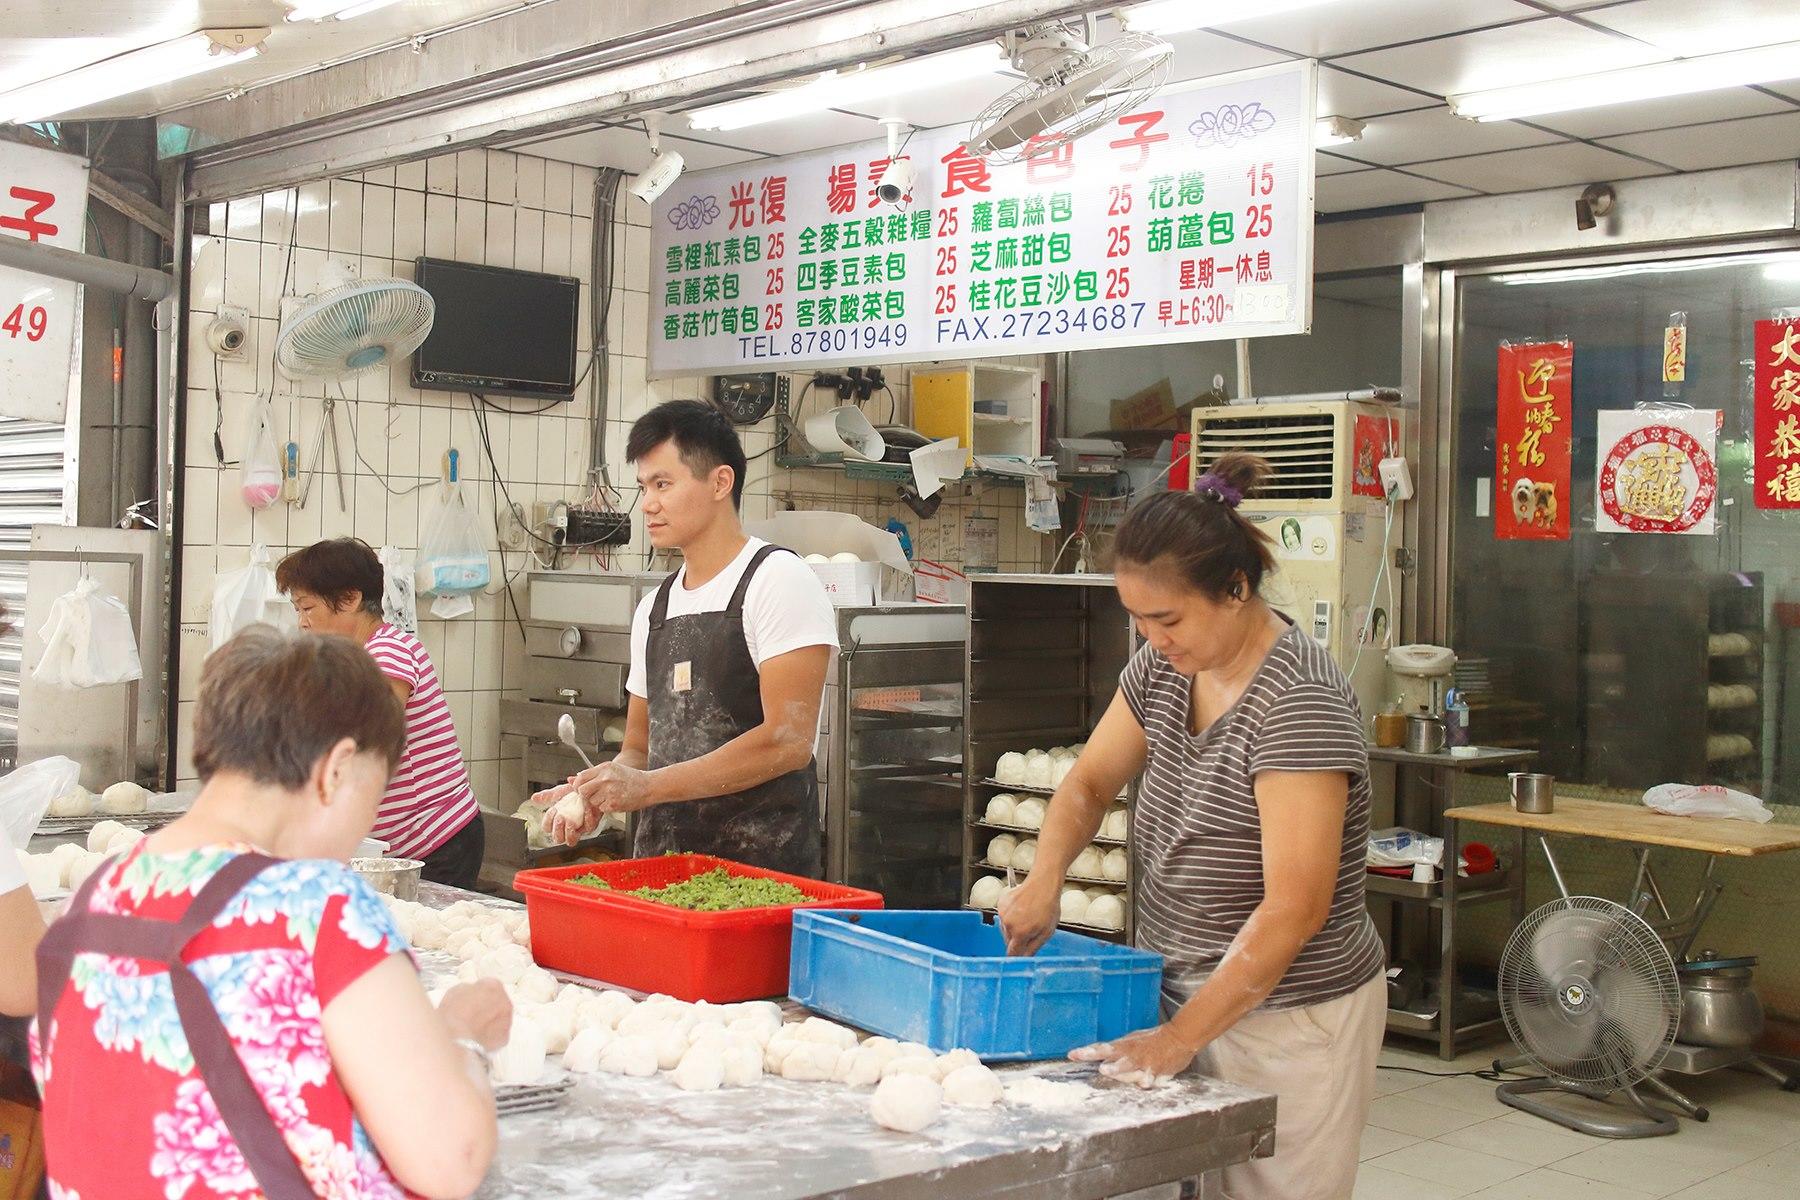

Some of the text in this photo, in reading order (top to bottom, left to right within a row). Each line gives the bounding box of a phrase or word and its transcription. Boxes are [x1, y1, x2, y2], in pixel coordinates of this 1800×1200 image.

[1147, 163, 1274, 210] 花捲 15
[971, 185, 1132, 233] 蘿蔔絲包 25
[1147, 204, 1273, 253] 葫蘆包 25
[666, 232, 784, 273] 雪裡紅素包 25
[798, 207, 958, 255] 全麥五穀雜糧 25
[970, 225, 1131, 272] 芝麻甜包 25
[665, 267, 784, 307] 高麗菜包 25
[797, 247, 957, 291] 四季豆素包 25
[968, 267, 1130, 312] 桂花豆沙包 25
[1179, 250, 1273, 291] 星期一休息
[663, 303, 783, 340] 香菇竹筍包 25
[796, 285, 956, 328] 客家酸菜包 25
[937, 302, 1146, 344] FAX.27234687
[739, 323, 907, 358] TEL.87801949
